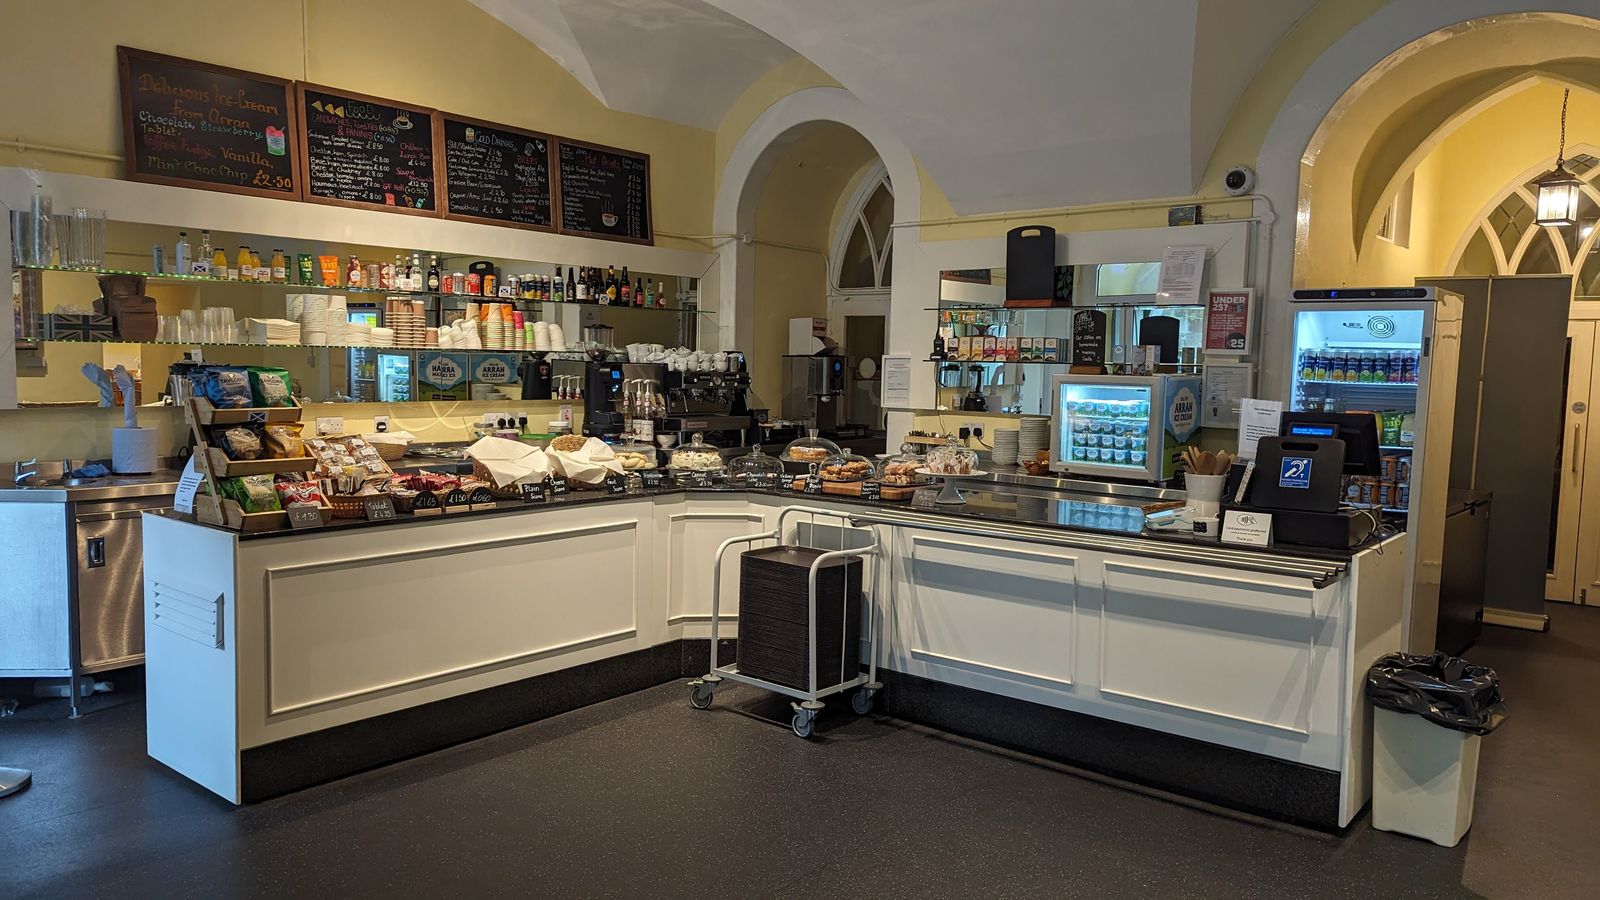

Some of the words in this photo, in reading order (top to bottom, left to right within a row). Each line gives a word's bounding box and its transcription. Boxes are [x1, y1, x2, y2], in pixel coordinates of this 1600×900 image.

[138, 73, 208, 102] Delicious
[208, 107, 250, 129] Arran
[1213, 296, 1245, 304] UNDER
[1230, 339, 1245, 348] 25
[1175, 402, 1193, 413] ARRAN
[1180, 413, 1193, 421] CREAM
[523, 484, 540, 492] Plain
[369, 501, 388, 510] Tablet
